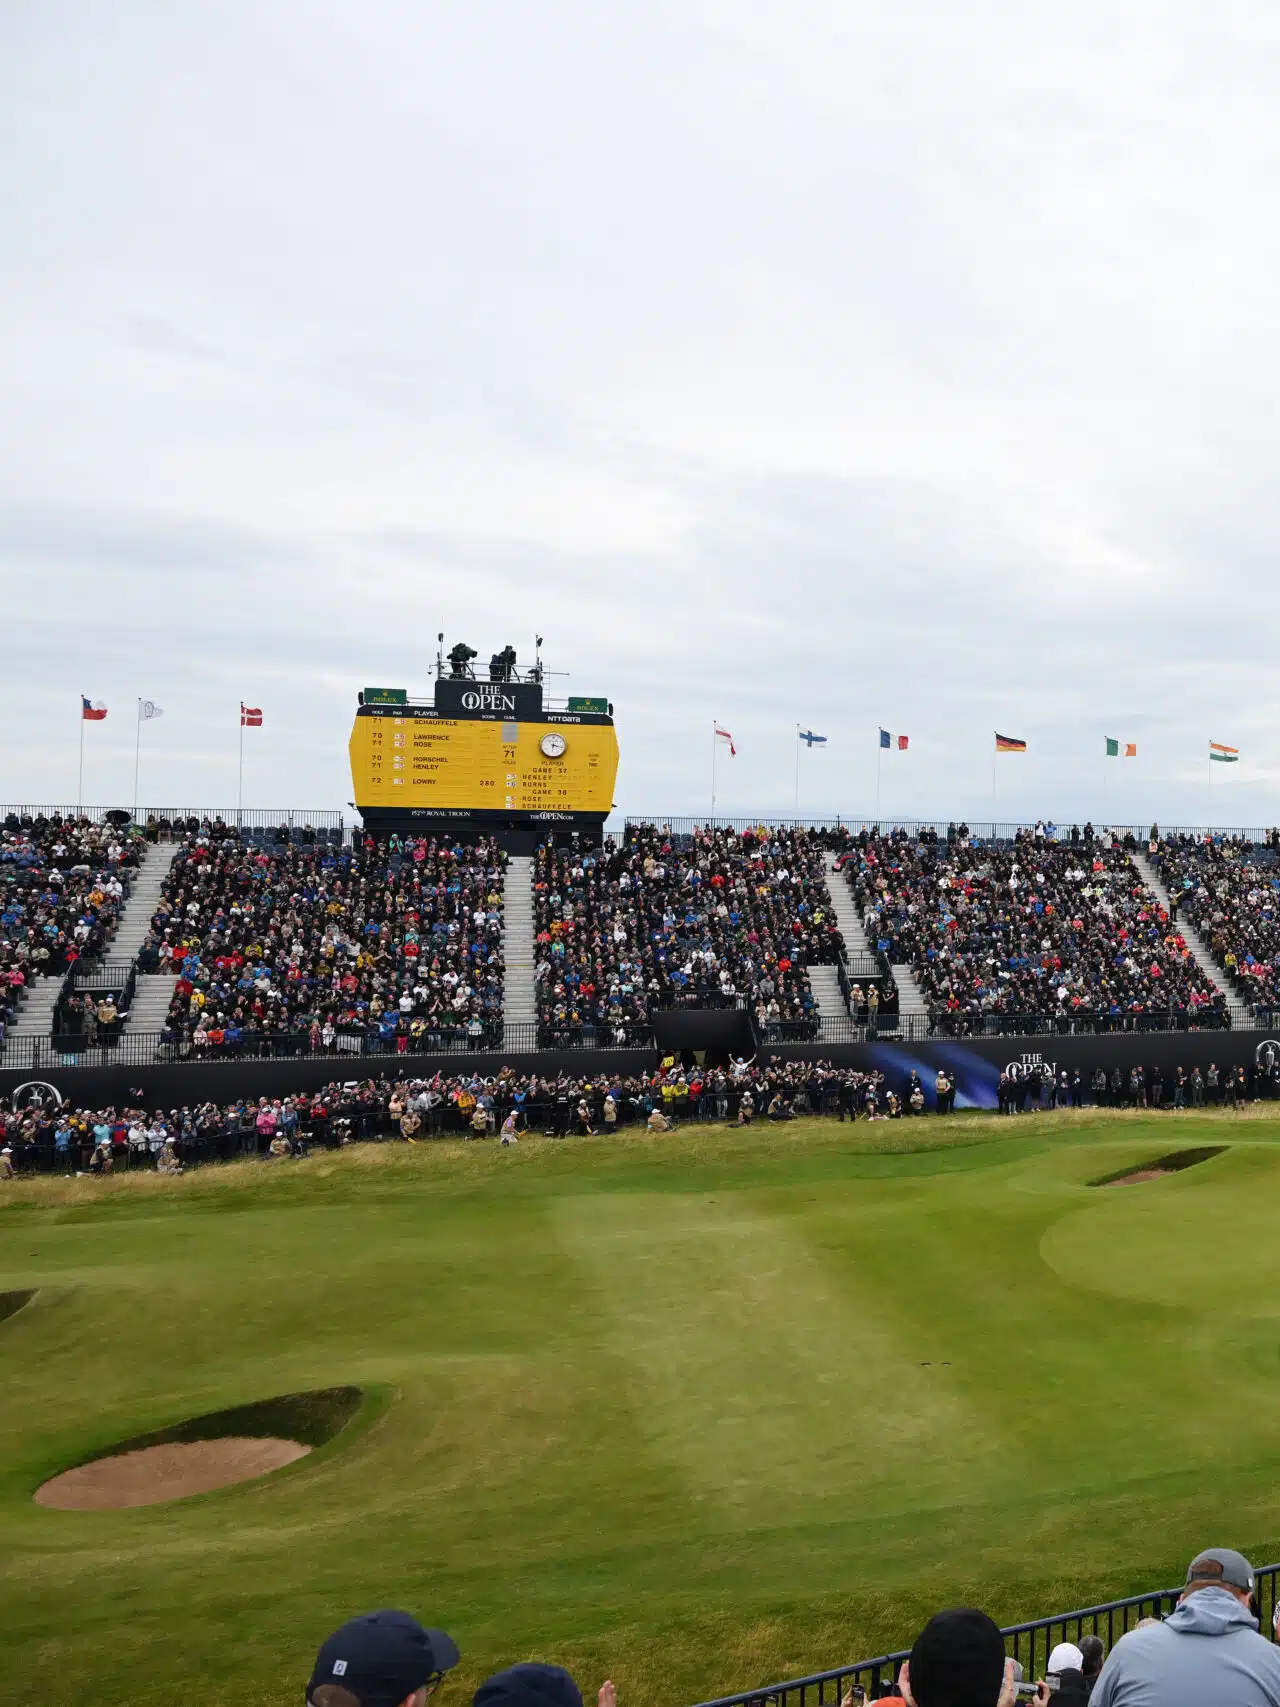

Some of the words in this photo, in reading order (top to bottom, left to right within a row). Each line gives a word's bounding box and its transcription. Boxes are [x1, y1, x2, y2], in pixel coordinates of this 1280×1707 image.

[478, 685, 501, 694] THE
[461, 692, 516, 710] OPEN
[504, 750, 515, 758] 71
[1020, 1053, 1043, 1063] THE
